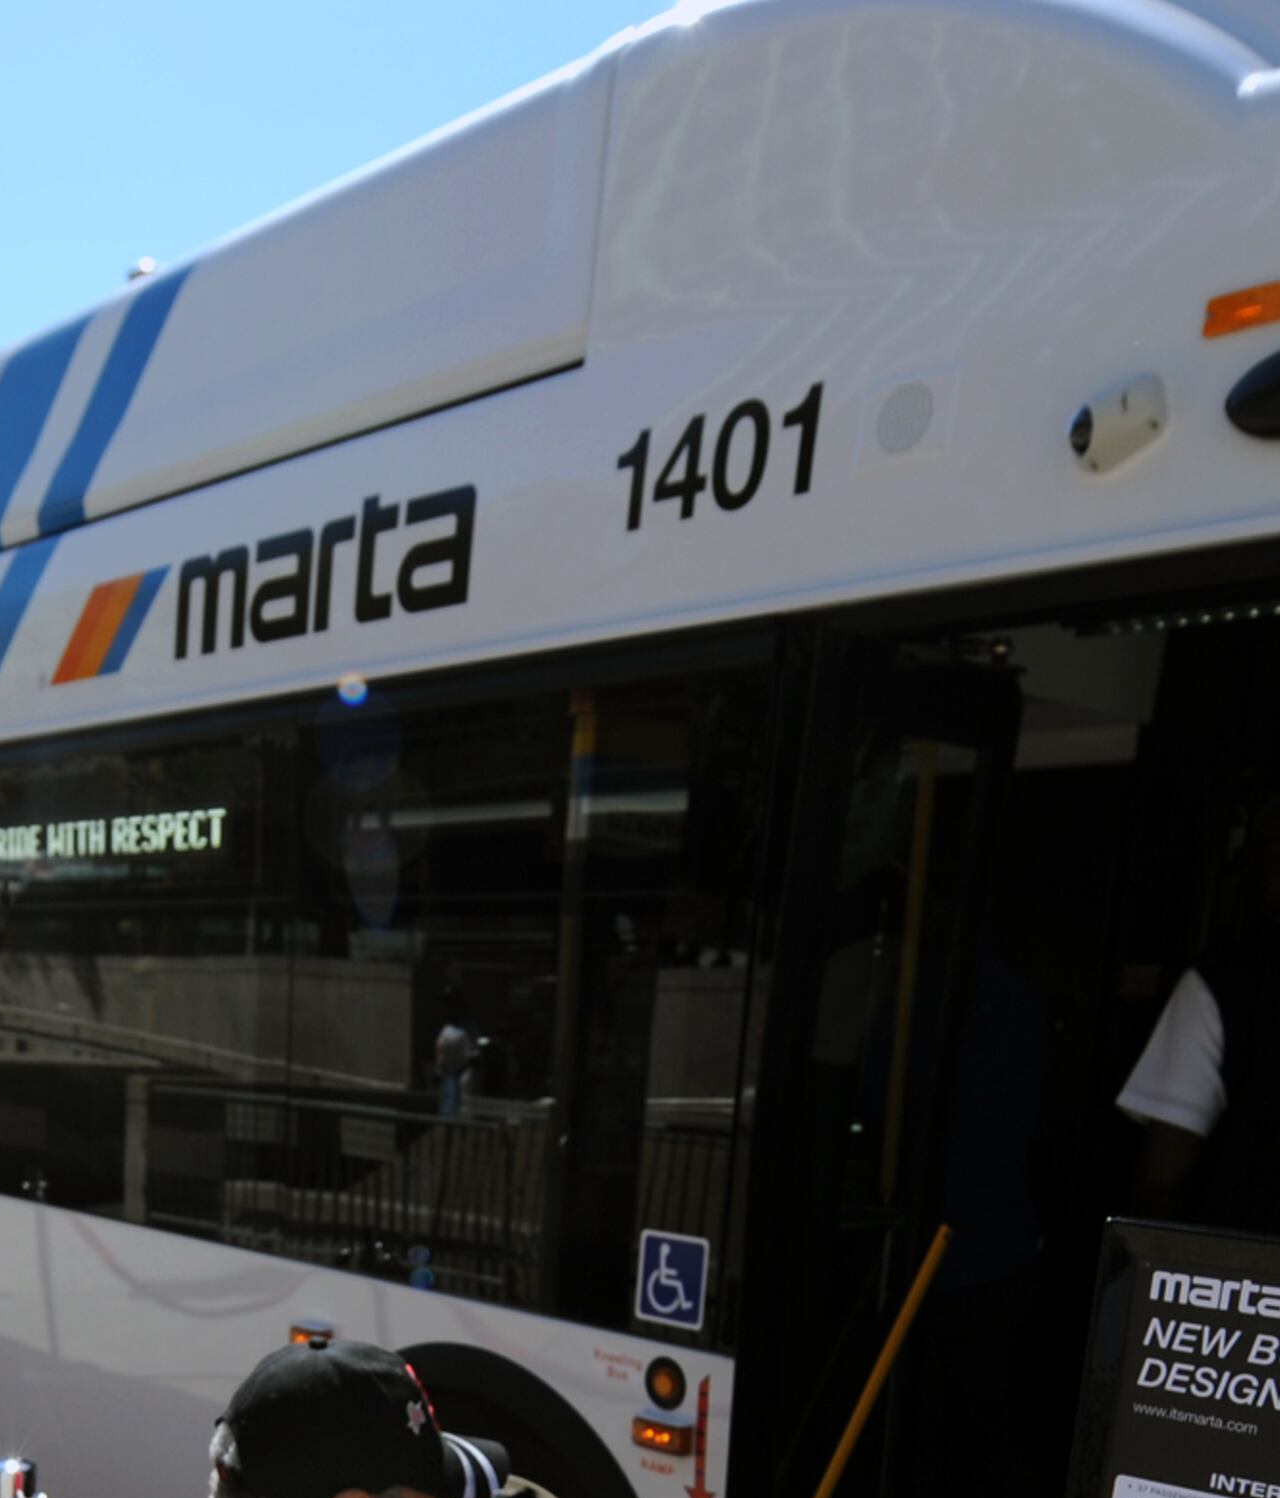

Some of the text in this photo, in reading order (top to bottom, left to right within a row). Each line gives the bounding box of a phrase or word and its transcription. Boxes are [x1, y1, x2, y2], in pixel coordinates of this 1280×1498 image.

[617, 381, 823, 532] 1401
[174, 483, 477, 660] marta
[46, 819, 106, 858] WITH
[111, 808, 227, 855] RESPECT
[1143, 1317, 1241, 1360] NEW
[1132, 1401, 1258, 1435] www.itsmarta.com
